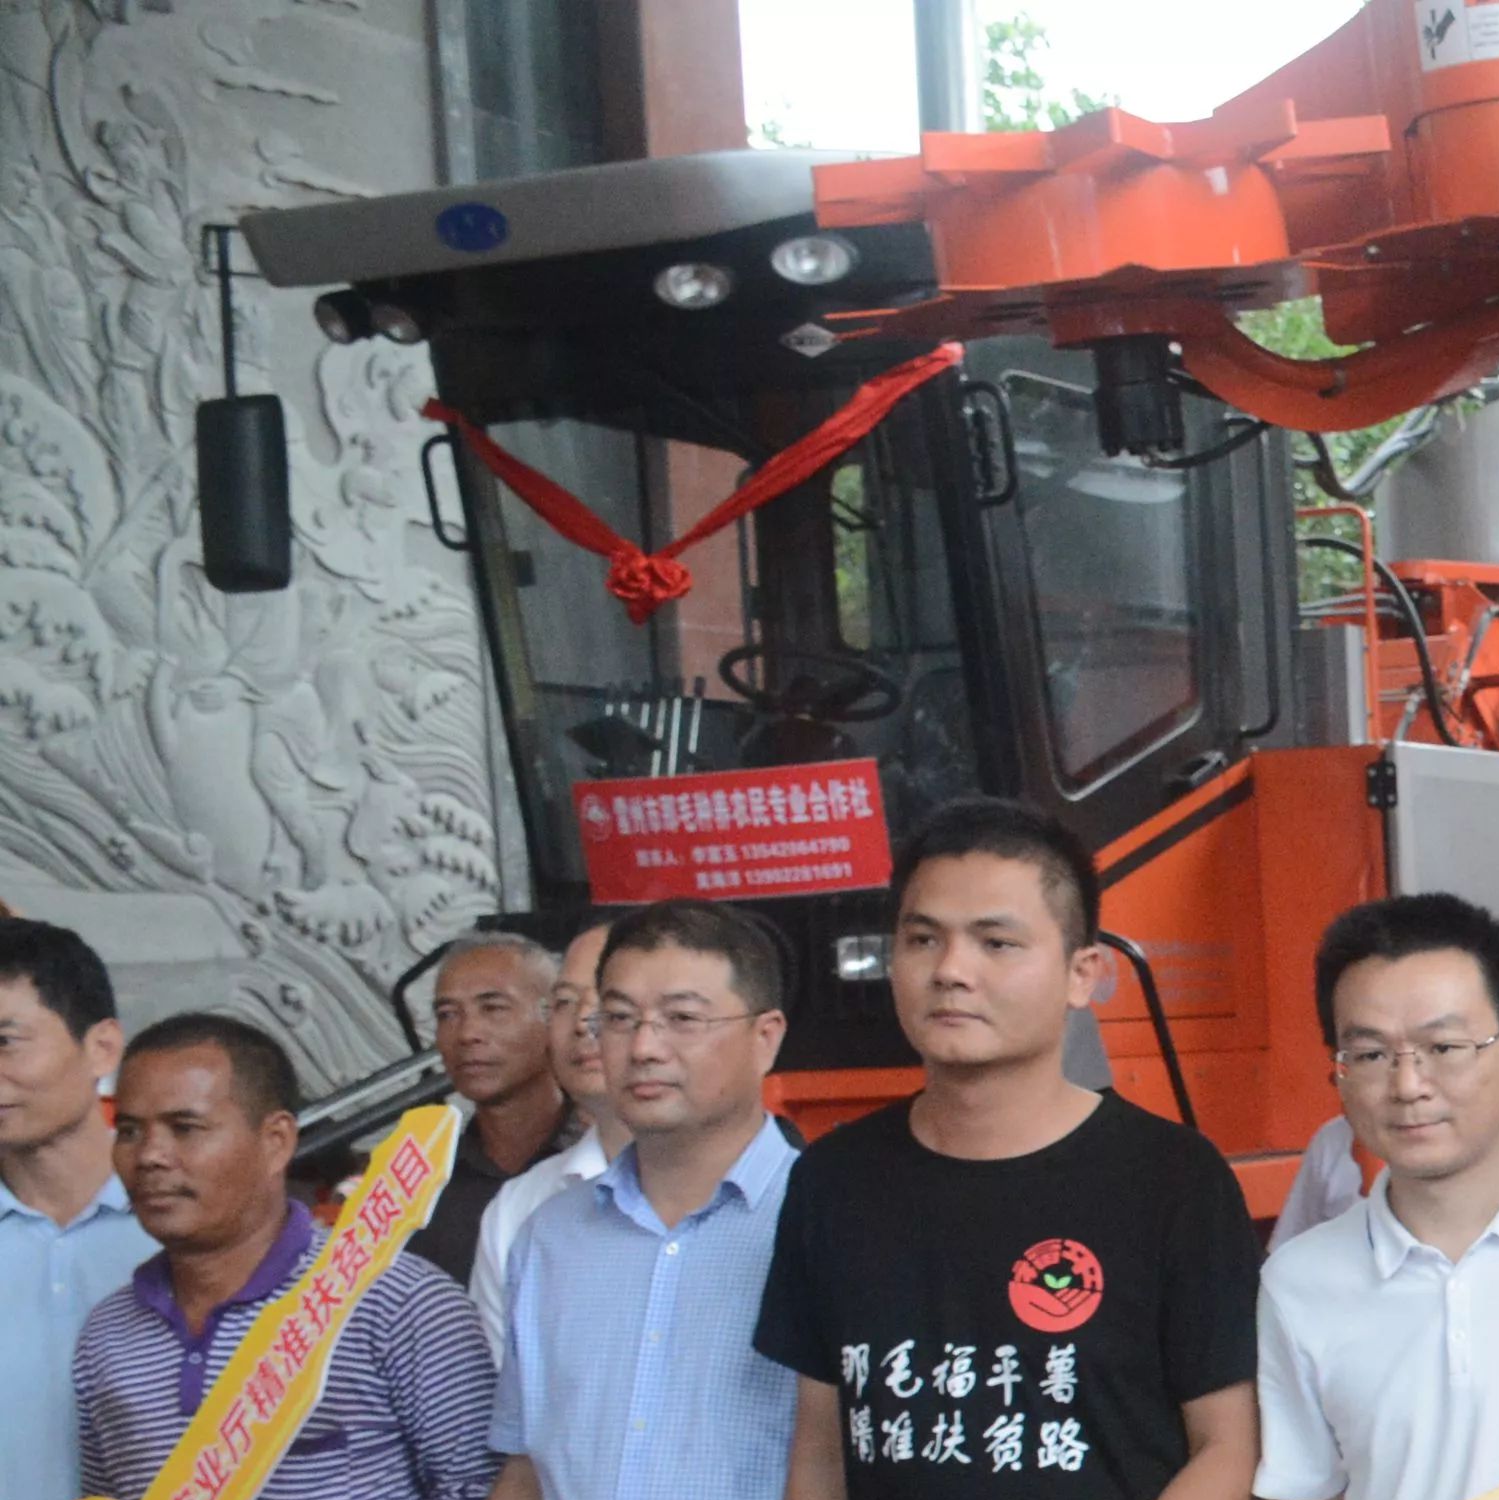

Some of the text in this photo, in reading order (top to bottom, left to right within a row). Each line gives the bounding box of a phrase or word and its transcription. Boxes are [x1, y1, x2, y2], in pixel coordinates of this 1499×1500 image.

[849, 1405, 1090, 1473] 精准扶贫路
